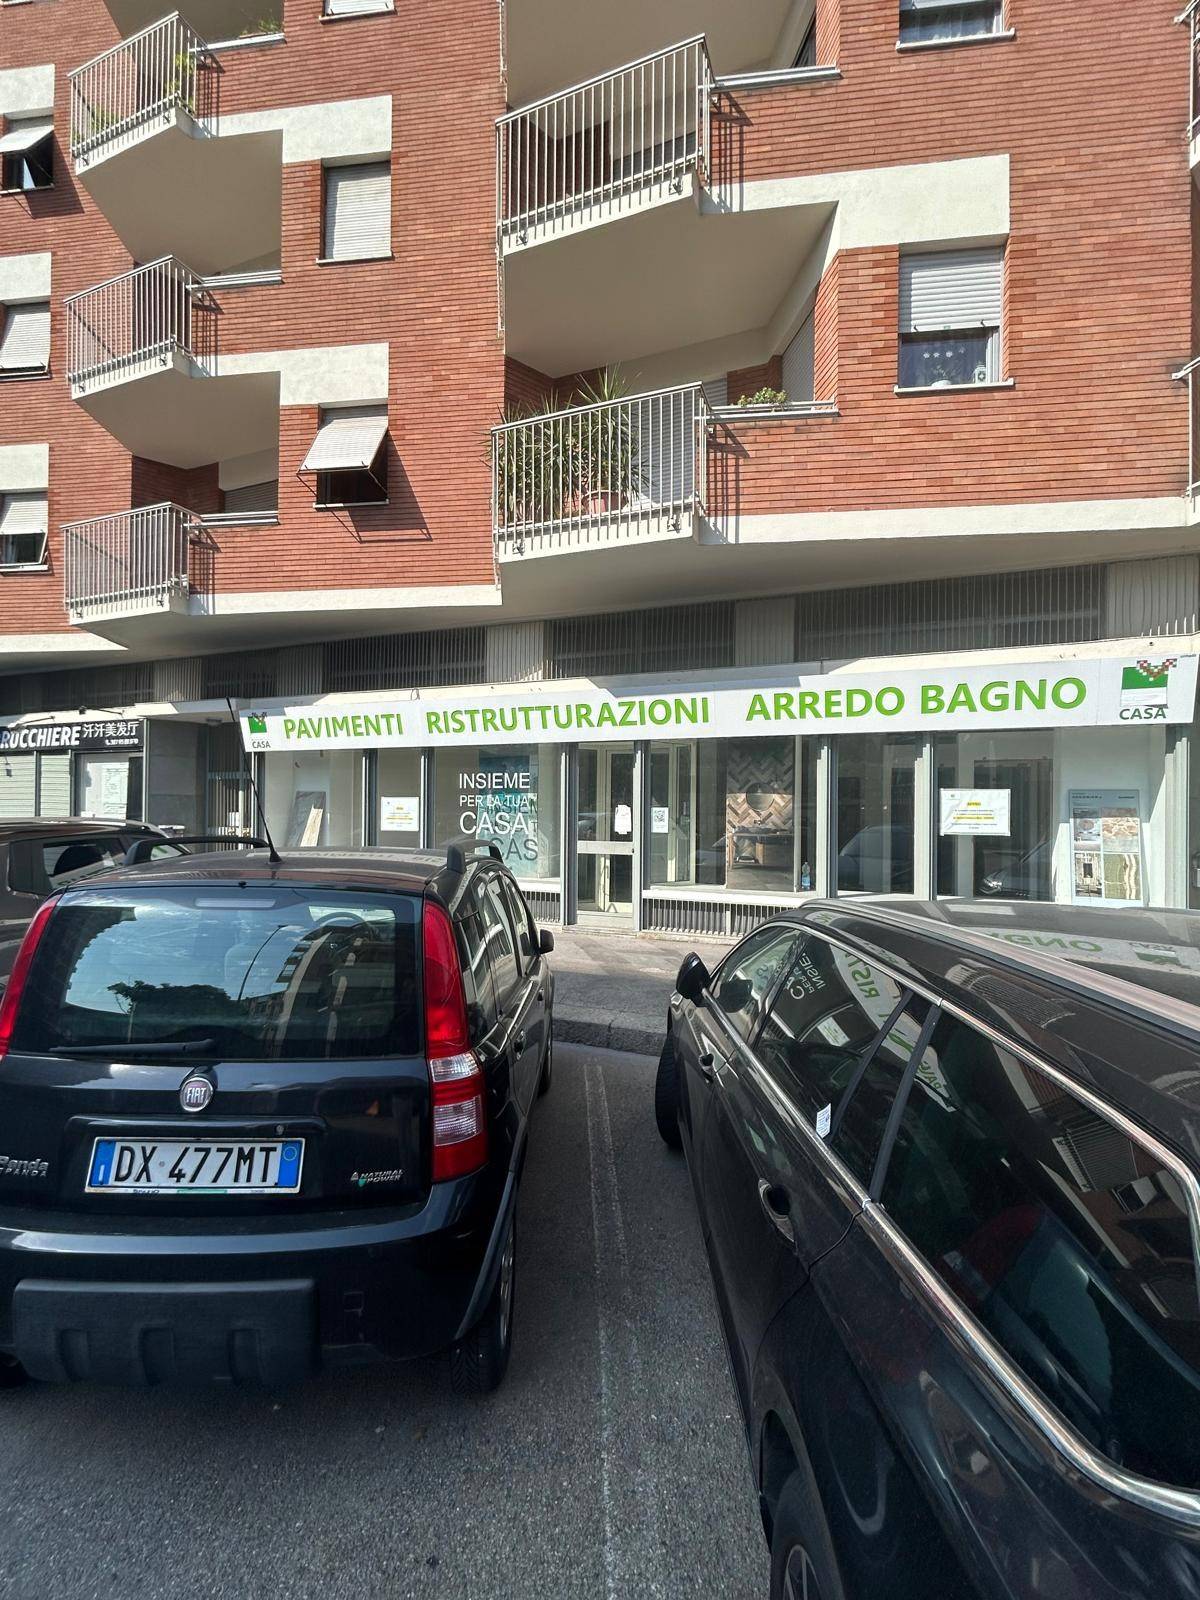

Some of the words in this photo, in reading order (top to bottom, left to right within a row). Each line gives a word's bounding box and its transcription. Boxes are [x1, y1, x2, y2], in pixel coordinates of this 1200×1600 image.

[283, 713, 404, 739] PAVIMENTI
[426, 697, 709, 735] RISTRUTTURAZIONI
[745, 686, 906, 721] ARREDO
[921, 677, 1087, 715] BAGNO
[1118, 707, 1167, 721] CASA
[0, 725, 82, 749] RUCCHIERE
[251, 740, 271, 749] CASA
[459, 772, 531, 789] INSIEME
[459, 794, 484, 807] PER
[504, 794, 529, 807] TUA
[459, 811, 530, 835] CASA
[186, 1086, 207, 1104] FIAT
[114, 1145, 158, 1182] DX
[168, 1147, 278, 1184] 477MT
[366, 1174, 401, 1184] POWER
